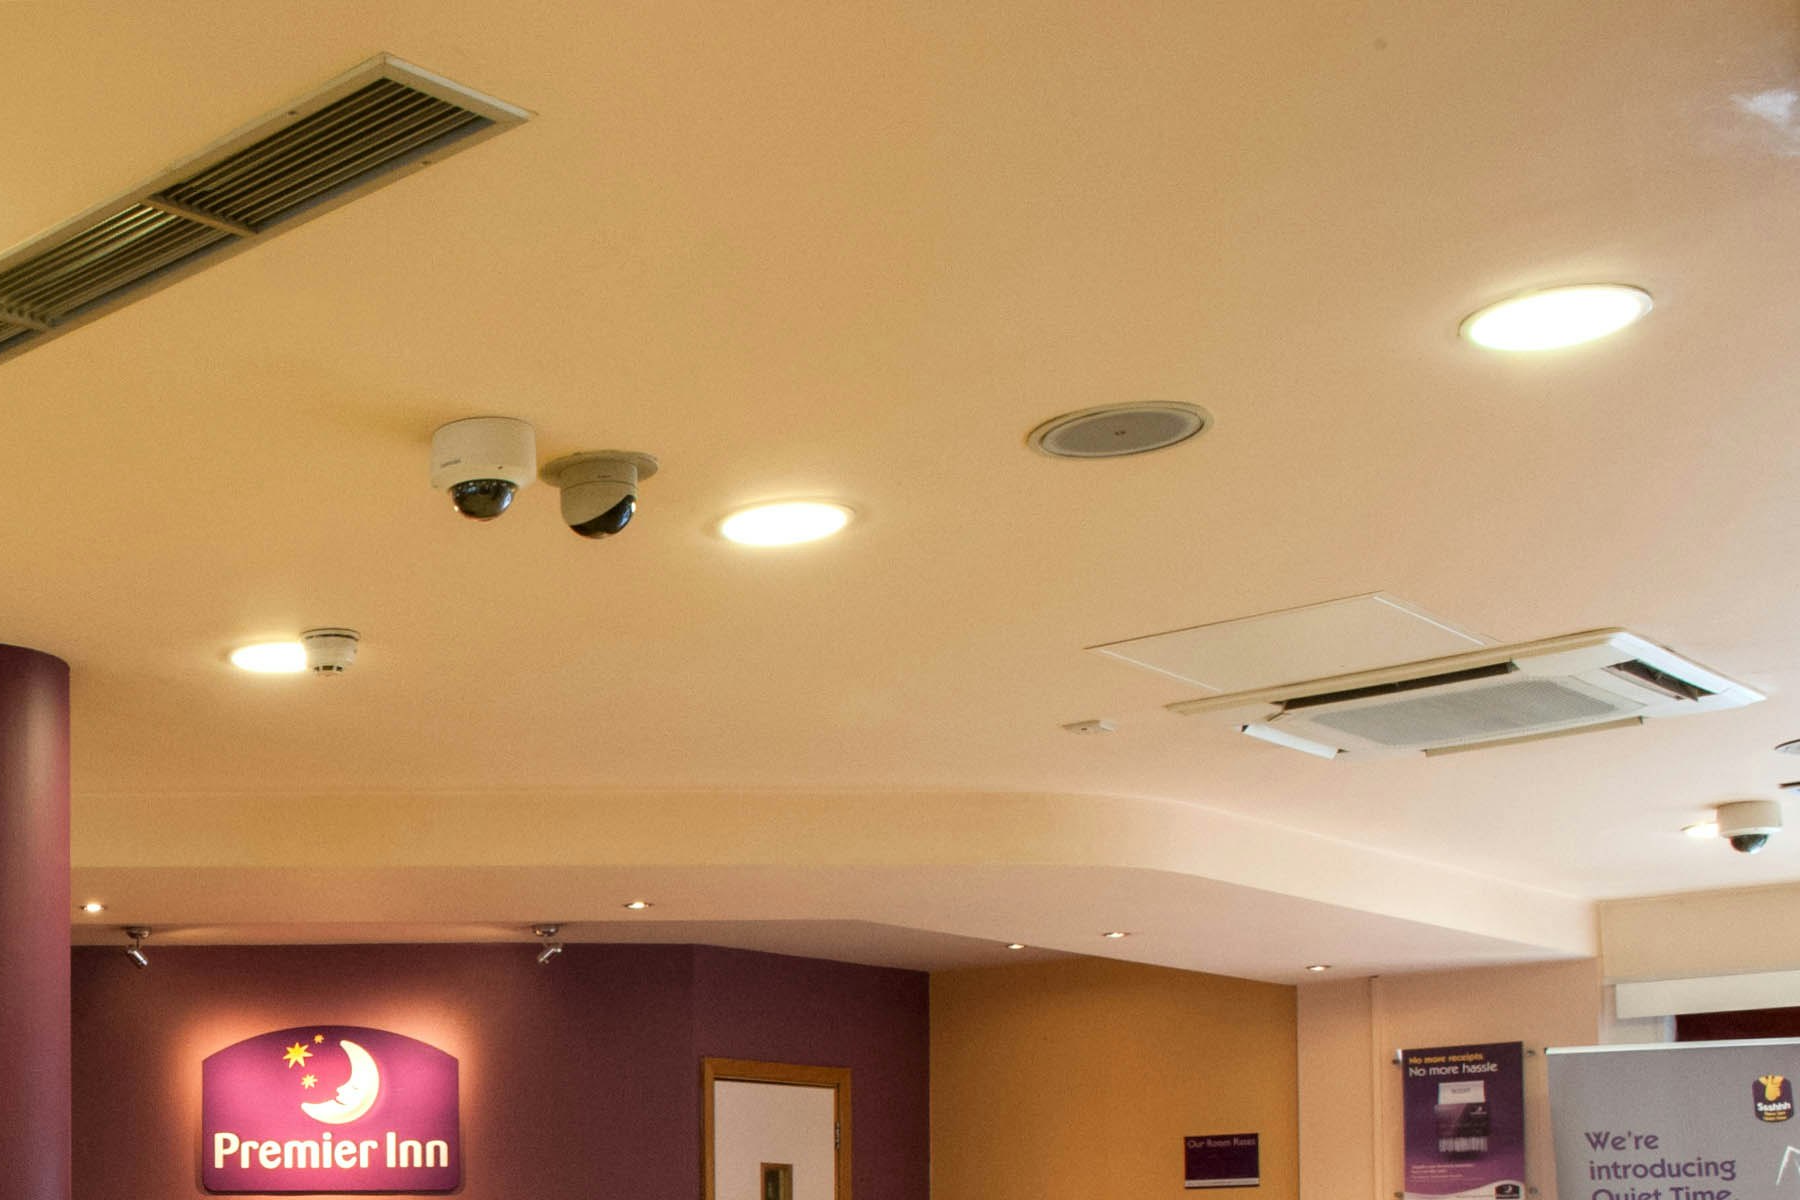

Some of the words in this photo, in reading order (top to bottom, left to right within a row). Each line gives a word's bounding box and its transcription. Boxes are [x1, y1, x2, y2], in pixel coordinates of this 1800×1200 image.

[1408, 1066, 1426, 1077] No
[1429, 1065, 1460, 1076] more
[1462, 1061, 1498, 1073] hassle
[213, 1131, 379, 1170] Premier
[386, 1131, 449, 1168] Inn
[1584, 1131, 1659, 1150] We're
[1589, 1157, 1737, 1181] introducing
